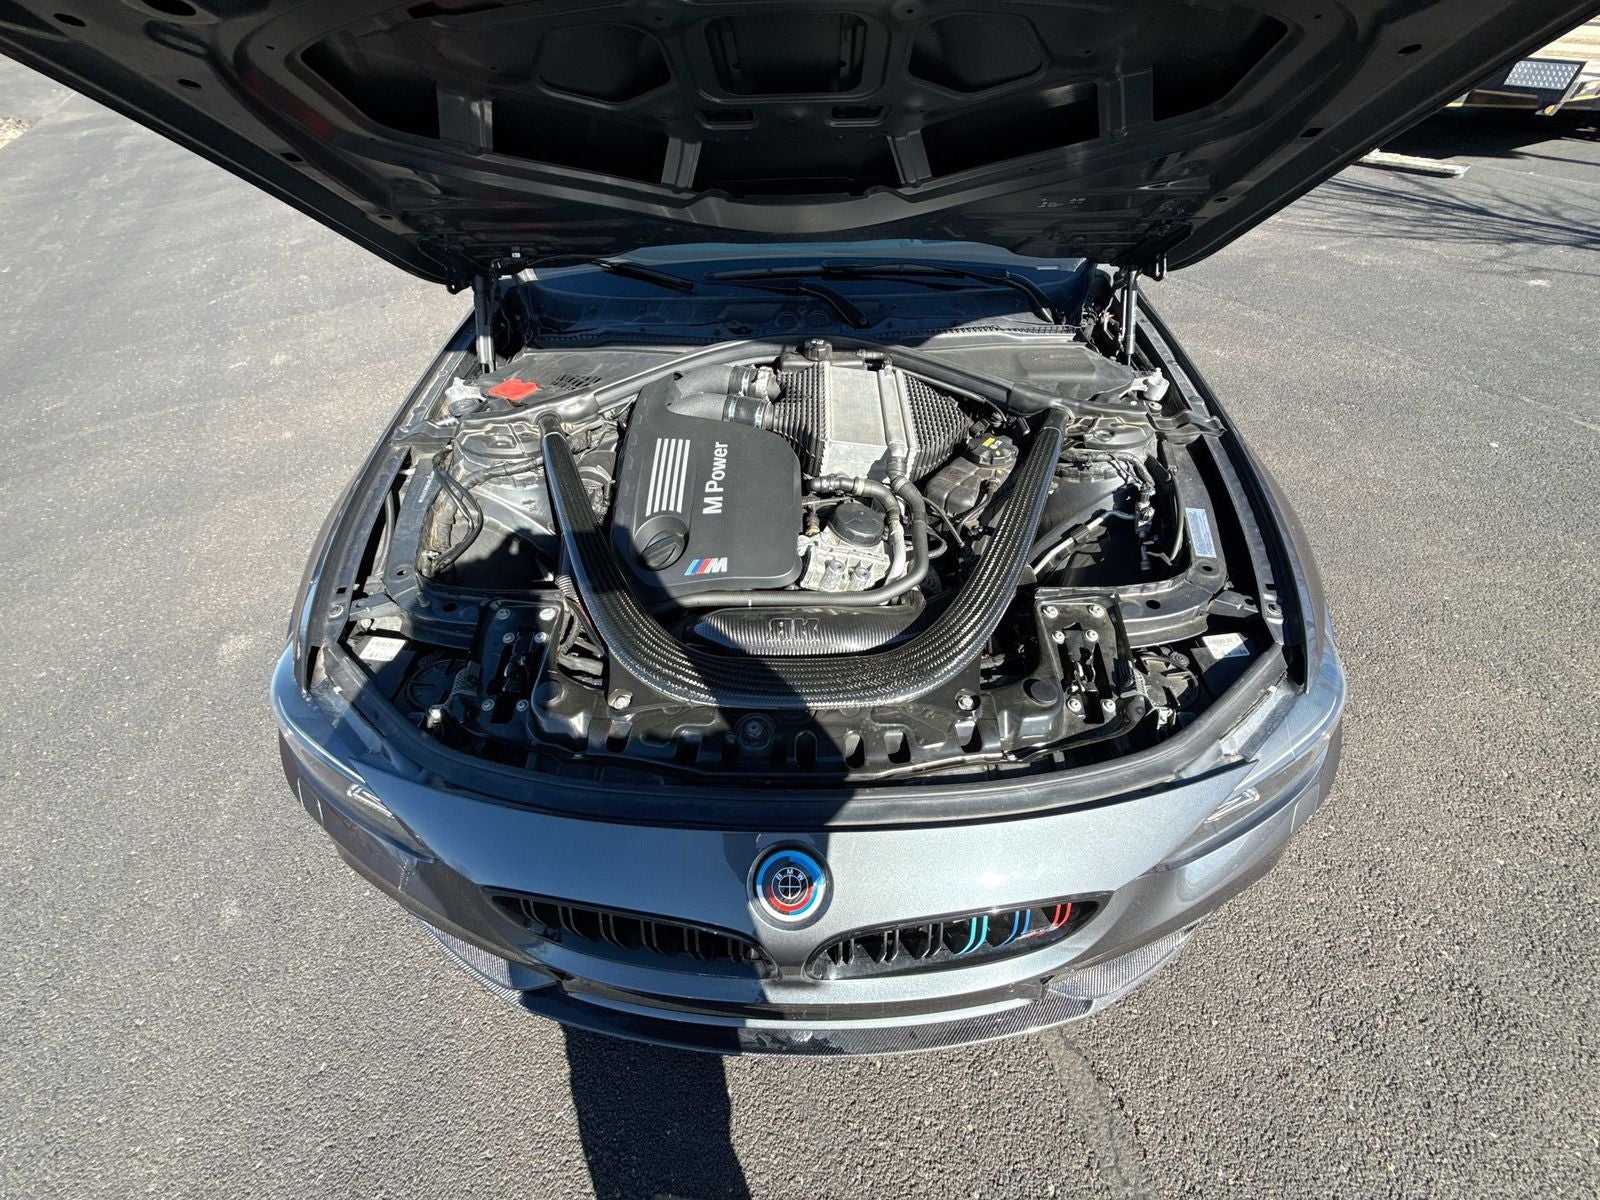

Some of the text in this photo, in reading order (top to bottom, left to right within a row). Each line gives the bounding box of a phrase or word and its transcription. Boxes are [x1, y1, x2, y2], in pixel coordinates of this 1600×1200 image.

[702, 441, 728, 514] M Power
[775, 868, 805, 881] BMW
